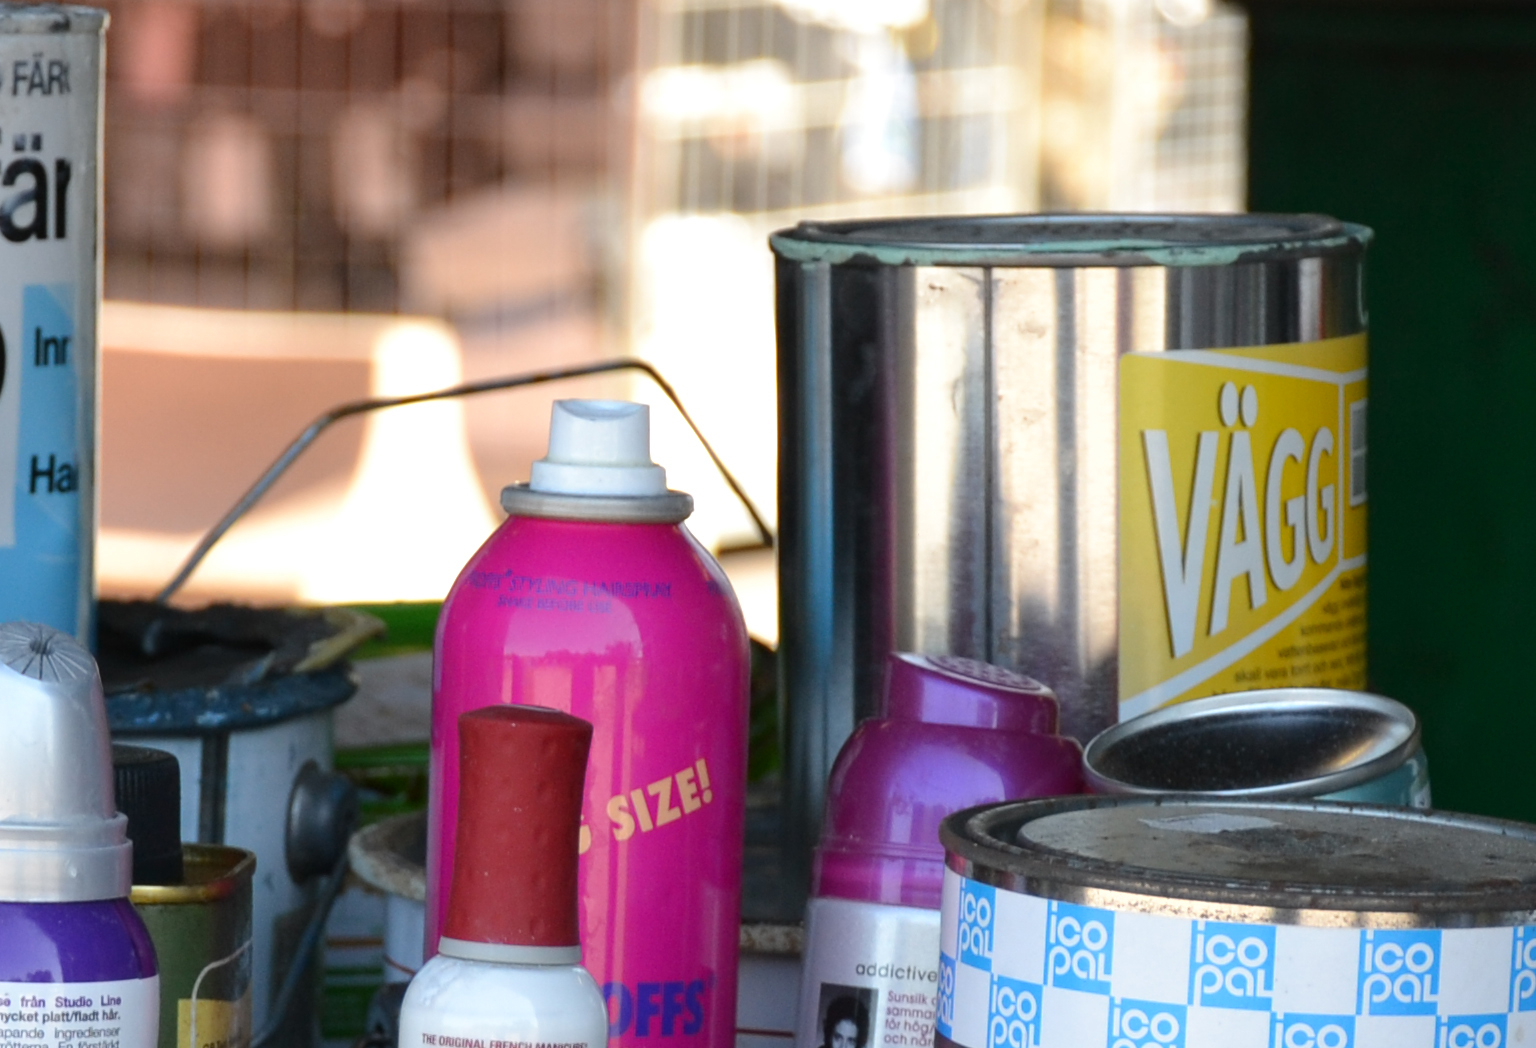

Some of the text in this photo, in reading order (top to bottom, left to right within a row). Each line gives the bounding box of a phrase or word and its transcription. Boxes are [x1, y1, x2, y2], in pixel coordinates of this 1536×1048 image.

[12, 52, 71, 96] FÄR
[1141, 380, 1335, 659] VÄGG
[607, 758, 712, 842] SIZE!
[1049, 901, 1108, 951] ico
[1195, 921, 1268, 967] ico
[856, 963, 937, 982] addictive
[1365, 929, 1434, 973] ico
[55, 996, 92, 1007] Studio
[888, 990, 928, 1005] Sunsilk
[422, 1033, 436, 1045] THE
[1113, 997, 1180, 1043] ico
